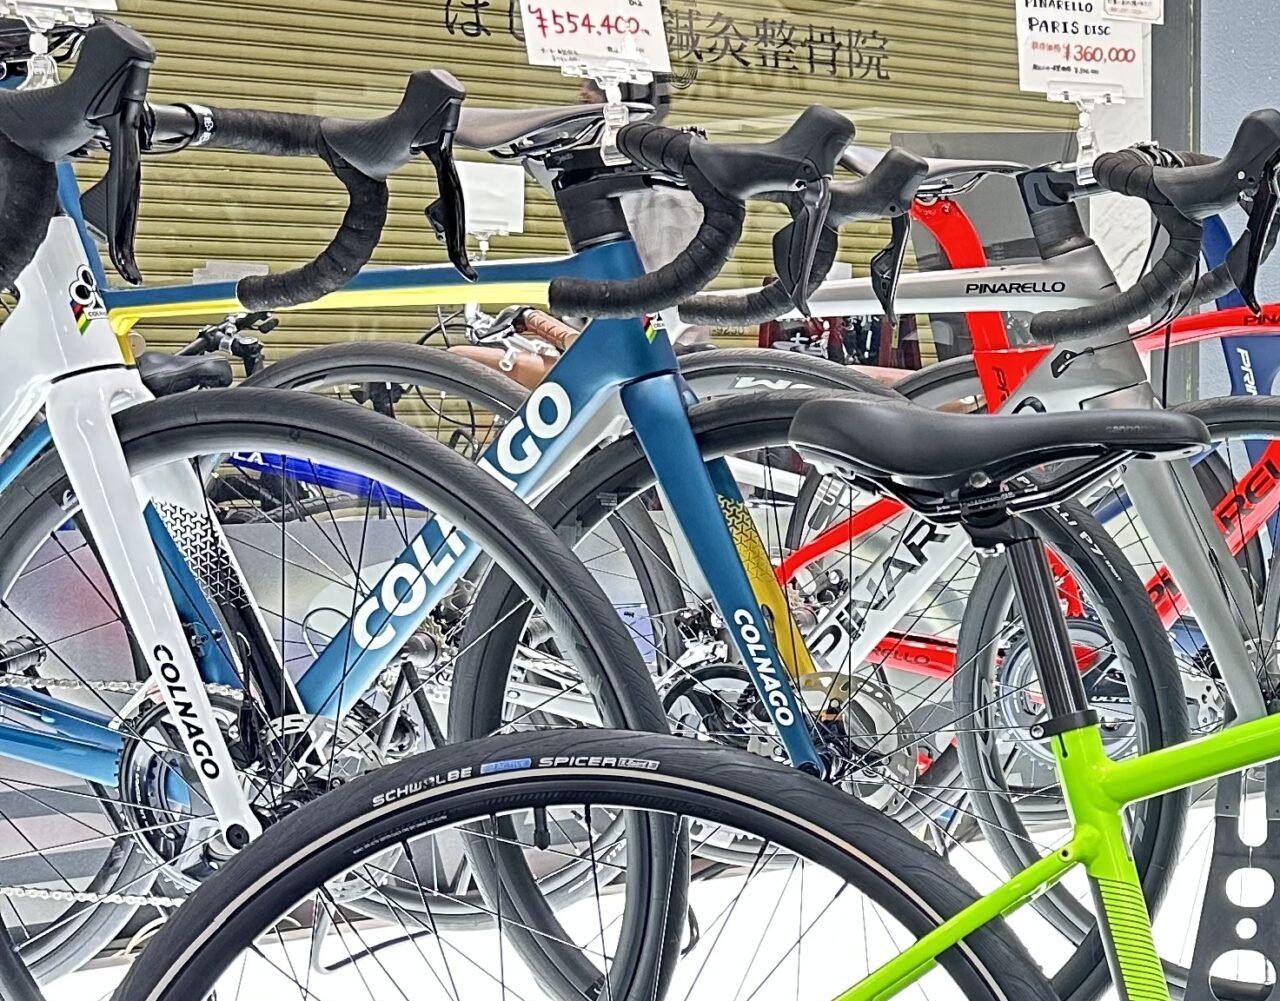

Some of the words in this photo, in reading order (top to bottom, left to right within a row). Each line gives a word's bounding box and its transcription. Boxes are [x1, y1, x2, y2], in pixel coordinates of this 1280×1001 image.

[1027, 16, 1080, 35] PARIS
[1084, 24, 1111, 36] DISC
[965, 281, 1066, 295] PINARELLO
[733, 608, 795, 727] COLNAGO
[1090, 694, 1132, 704] ULTE
[152, 643, 220, 781] COLNAGO
[537, 756, 618, 768] SPICER
